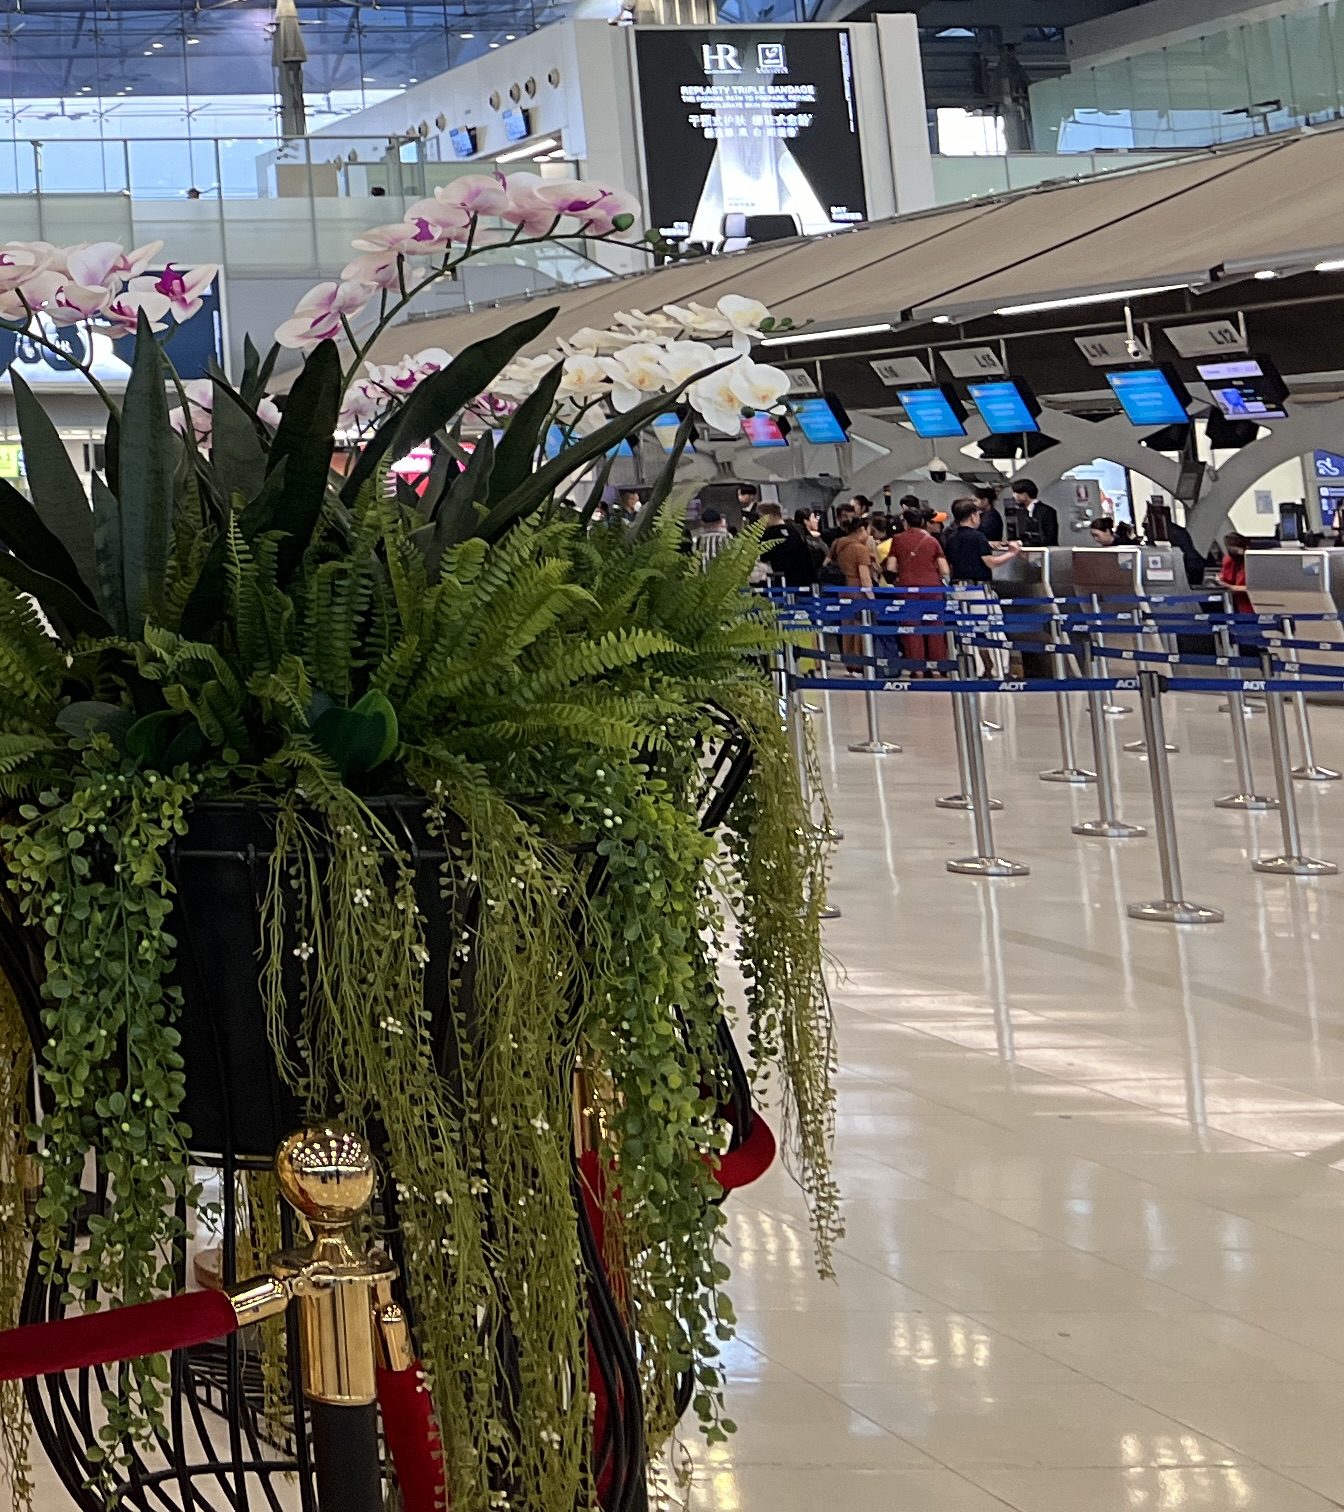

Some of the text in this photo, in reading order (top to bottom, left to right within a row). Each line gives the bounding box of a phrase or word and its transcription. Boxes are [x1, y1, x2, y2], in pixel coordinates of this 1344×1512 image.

[702, 44, 742, 70] HR
[1208, 329, 1238, 345] L12
[1083, 343, 1109, 358] L14
[973, 353, 998, 369] L15
[883, 682, 912, 691] AOT
[999, 682, 1027, 691] AOT
[1243, 681, 1266, 690] AOT
